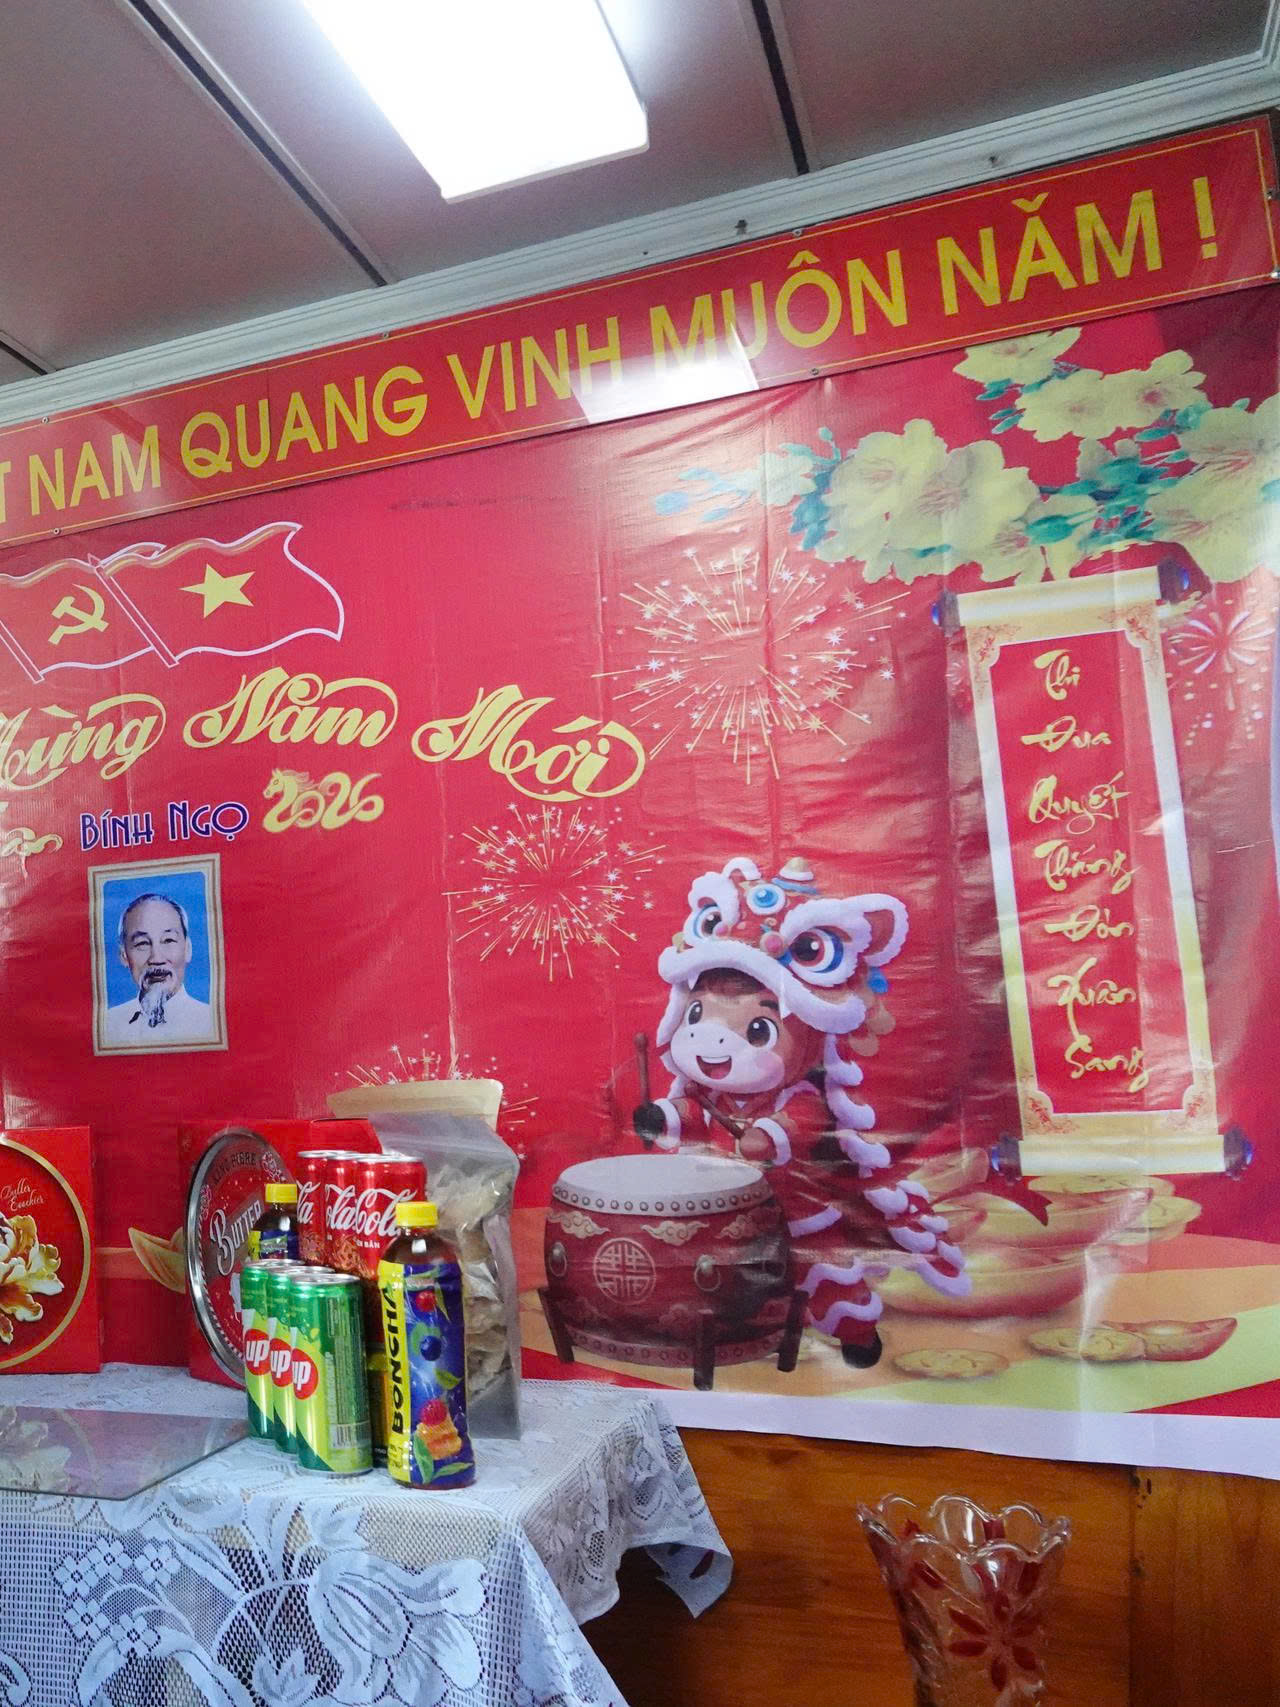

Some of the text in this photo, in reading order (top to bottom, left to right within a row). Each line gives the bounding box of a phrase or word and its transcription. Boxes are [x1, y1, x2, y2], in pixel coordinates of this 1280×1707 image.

[28, 425, 161, 516] NAM
[180, 364, 428, 480] QUANG
[446, 316, 622, 420] VINH
[649, 249, 909, 378] MUÔN
[935, 192, 1163, 316] NĂM
[1192, 176, 1219, 261] !
[1034, 649, 1081, 700] Thi
[182, 666, 398, 749] Năm
[411, 684, 646, 801] Mới
[1021, 715, 1112, 752] Đua
[80, 809, 154, 851] BÍNH
[168, 800, 250, 842] NGỌ
[261, 767, 385, 833] 2026
[1028, 771, 1131, 835] Quyết
[1064, 1034, 1150, 1093] Sang
